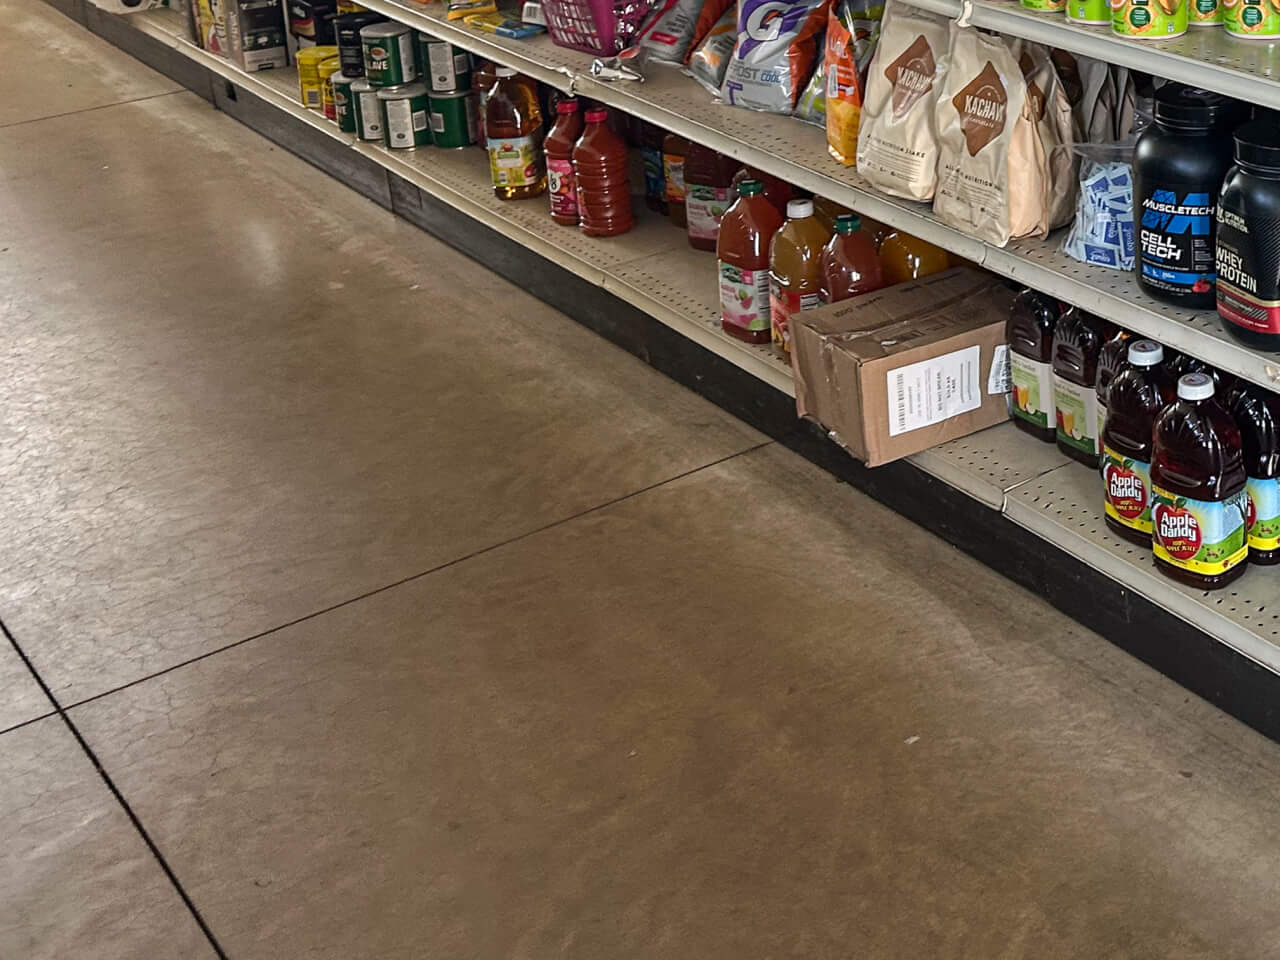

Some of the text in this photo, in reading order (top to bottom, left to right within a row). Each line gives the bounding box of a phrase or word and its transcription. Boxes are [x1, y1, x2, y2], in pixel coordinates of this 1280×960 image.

[1142, 198, 1215, 216] MUSCLETECH
[1140, 229, 1176, 249] CELL
[1140, 241, 1184, 261] TECH
[1216, 245, 1243, 270] WHEY
[1216, 261, 1257, 293] PROTEIN
[1110, 473, 1143, 489] Apple
[1111, 484, 1142, 500] Dandy
[1160, 510, 1198, 528] Apple
[1161, 522, 1197, 540] Dandy
